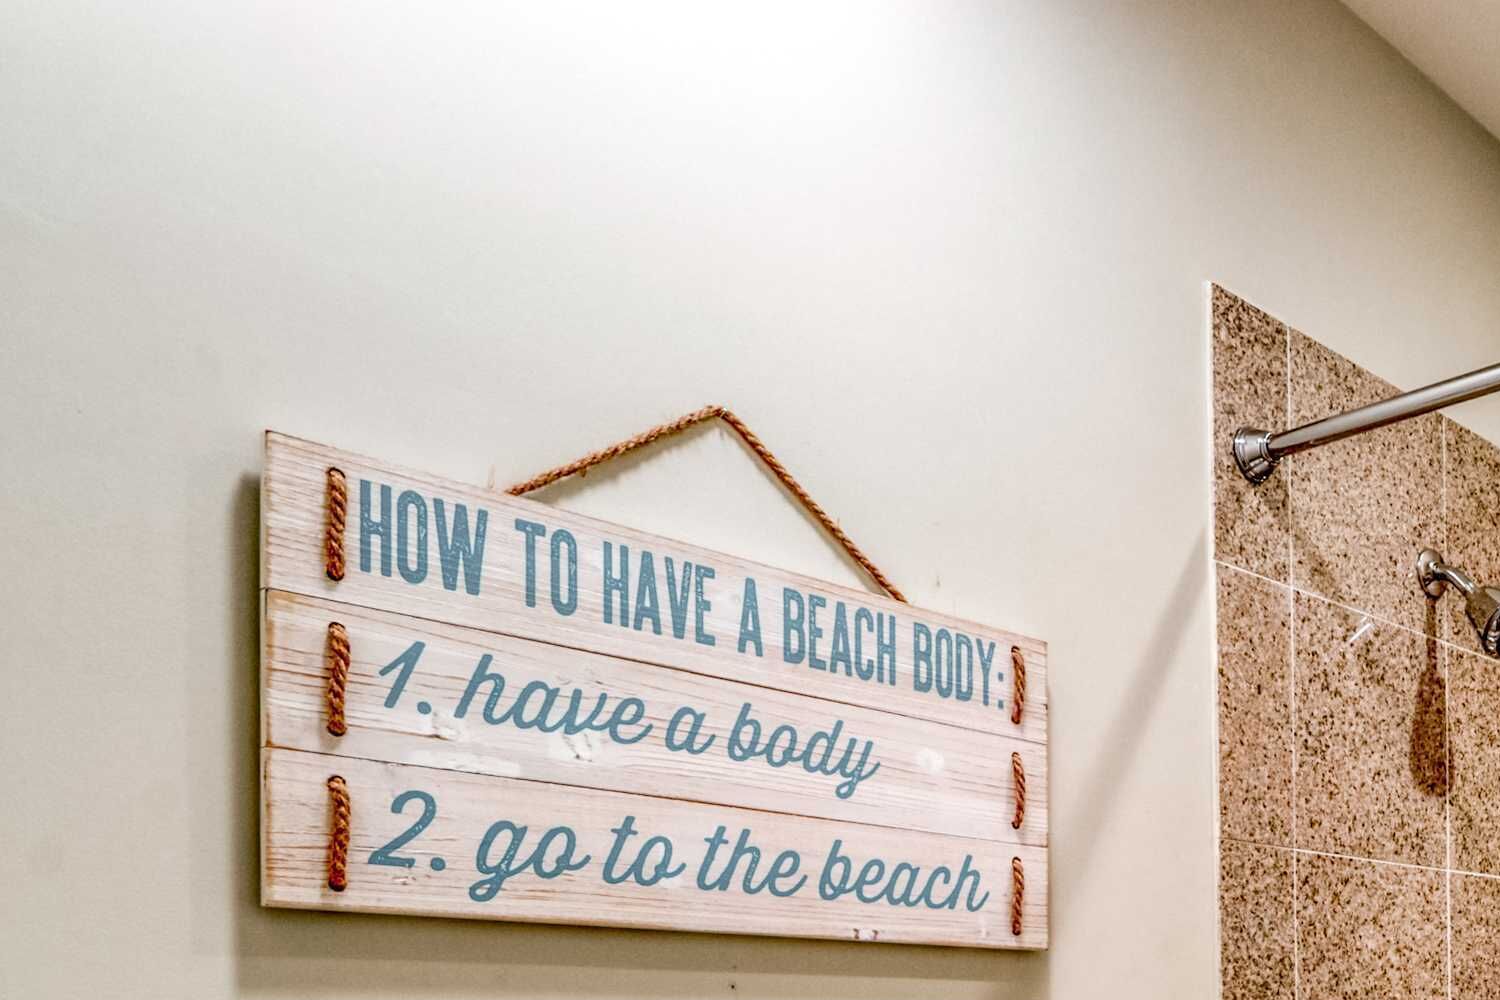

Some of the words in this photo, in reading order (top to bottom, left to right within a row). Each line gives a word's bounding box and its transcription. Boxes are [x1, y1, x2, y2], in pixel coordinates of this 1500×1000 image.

[359, 479, 488, 597] HOW
[514, 518, 578, 616] TO
[603, 541, 716, 647] HAVE
[737, 576, 763, 657] A
[783, 587, 896, 687] BEACH
[913, 623, 1005, 710] BODY:
[378, 640, 433, 717] 1.
[454, 653, 654, 745] have
[665, 705, 717, 755] a
[727, 703, 881, 800] body
[367, 790, 447, 872] 2.
[469, 819, 592, 903] go
[603, 815, 688, 886] to
[695, 824, 807, 897] the
[818, 839, 990, 913] beach
